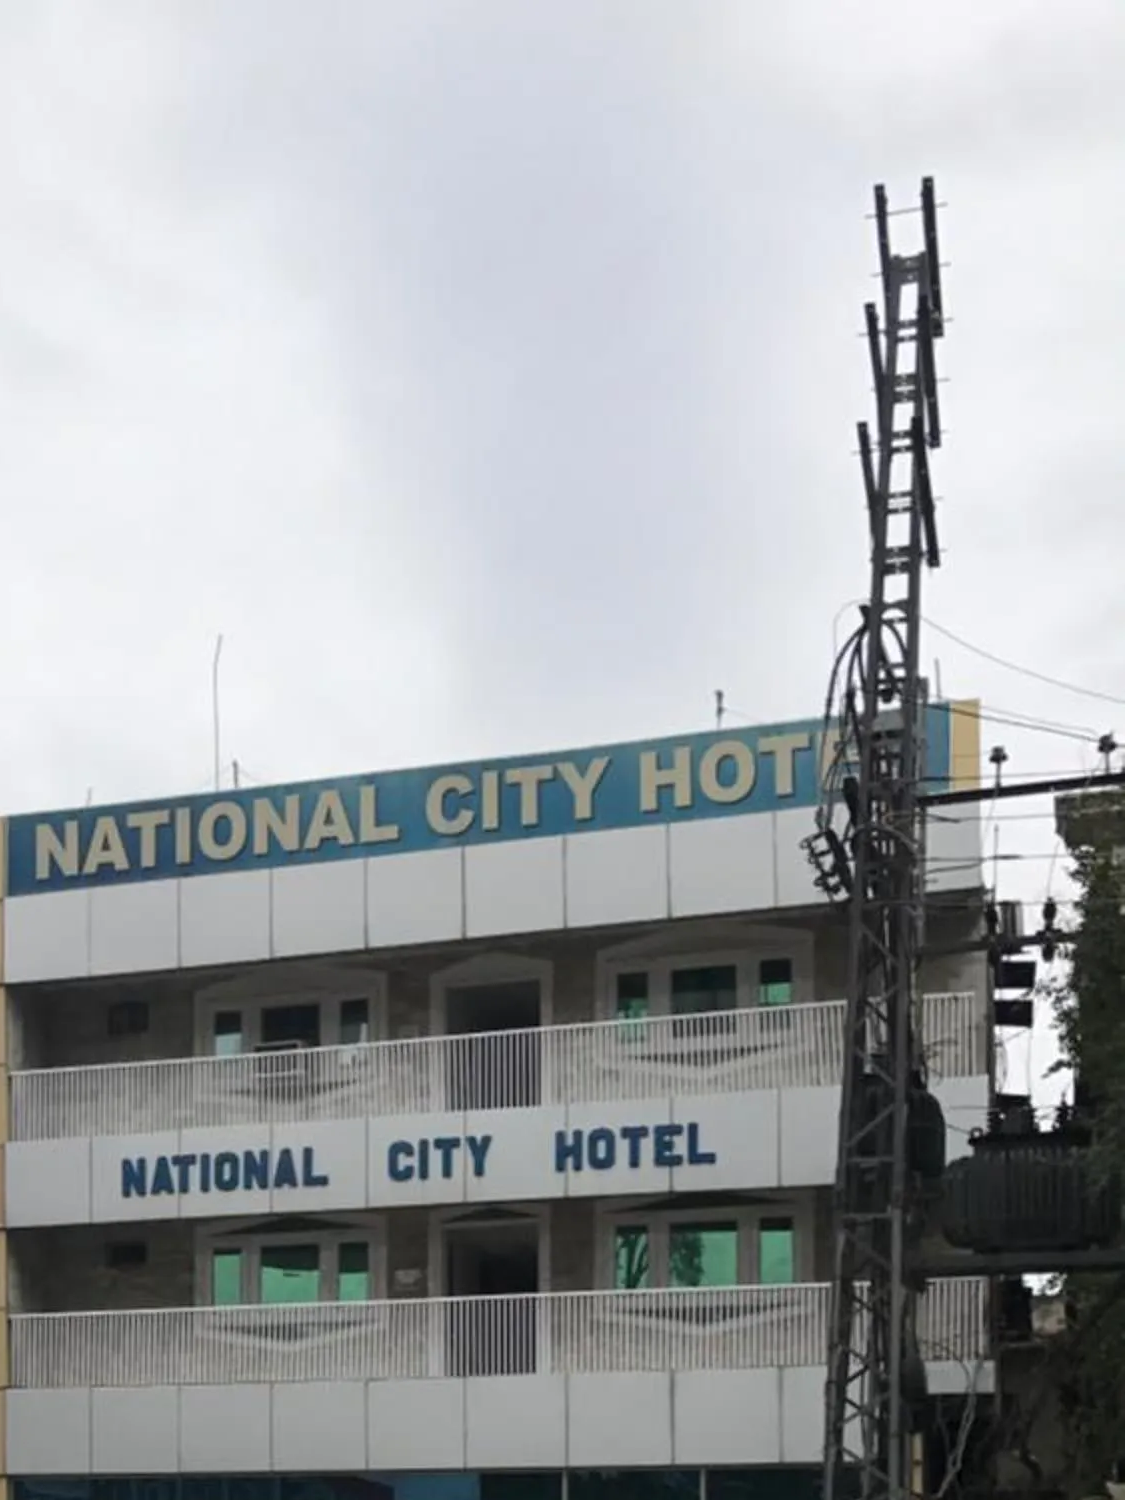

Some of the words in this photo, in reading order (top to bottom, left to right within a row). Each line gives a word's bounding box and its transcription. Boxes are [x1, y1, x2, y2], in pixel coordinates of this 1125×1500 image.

[35, 784, 400, 880] NATIONAL
[426, 756, 612, 837] CITY
[121, 1147, 329, 1198] NATIONAL
[387, 1135, 493, 1182] CITY
[554, 1122, 717, 1173] HOTEL
